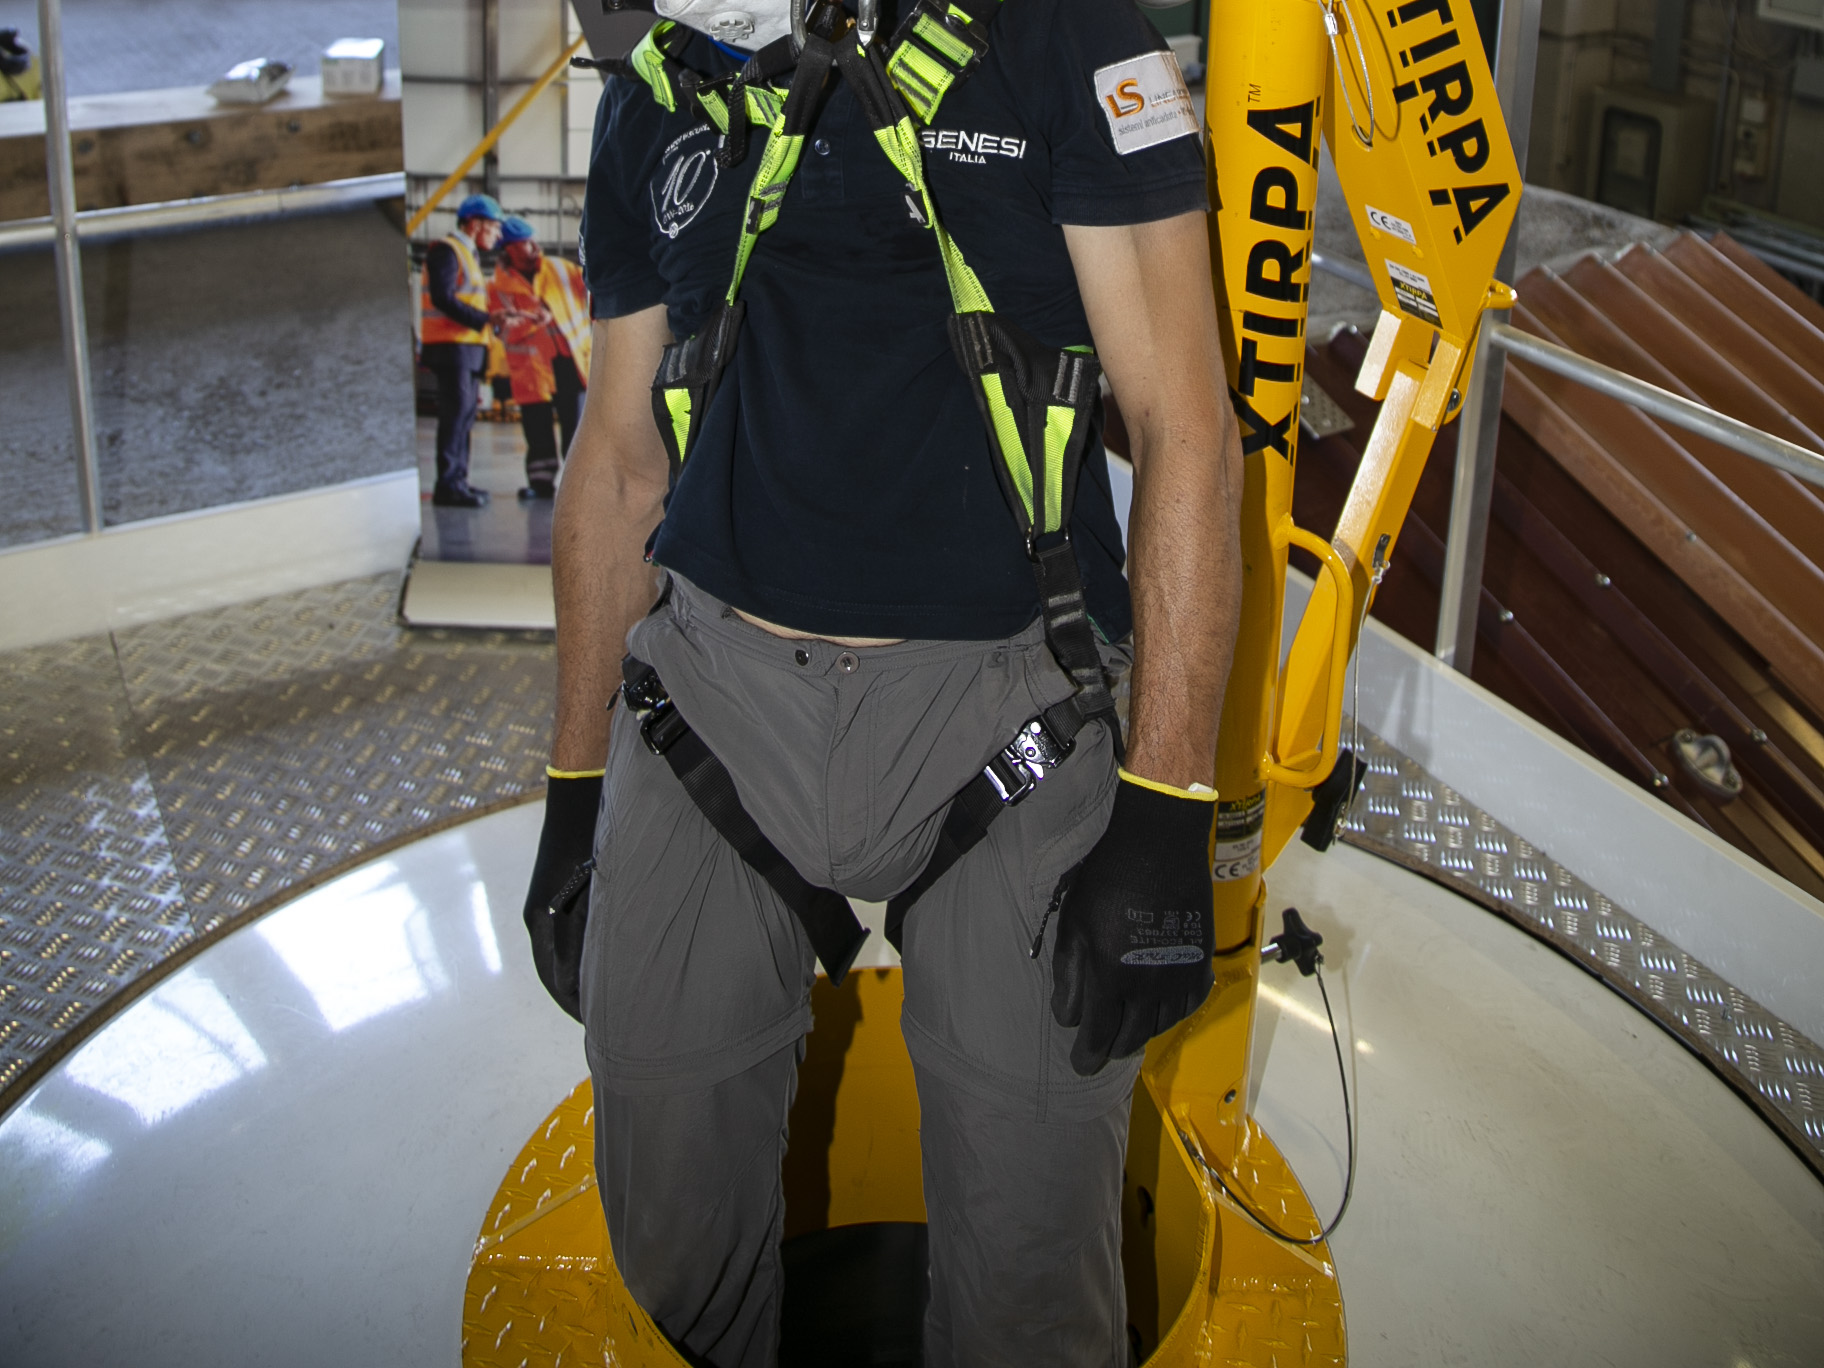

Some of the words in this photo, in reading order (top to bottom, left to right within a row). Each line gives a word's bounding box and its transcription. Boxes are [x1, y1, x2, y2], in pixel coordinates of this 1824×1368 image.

[1105, 77, 1145, 119] LS
[949, 151, 987, 164] ITALIA
[1226, 96, 1322, 466] XTIRPA
[1214, 861, 1241, 879] CE
